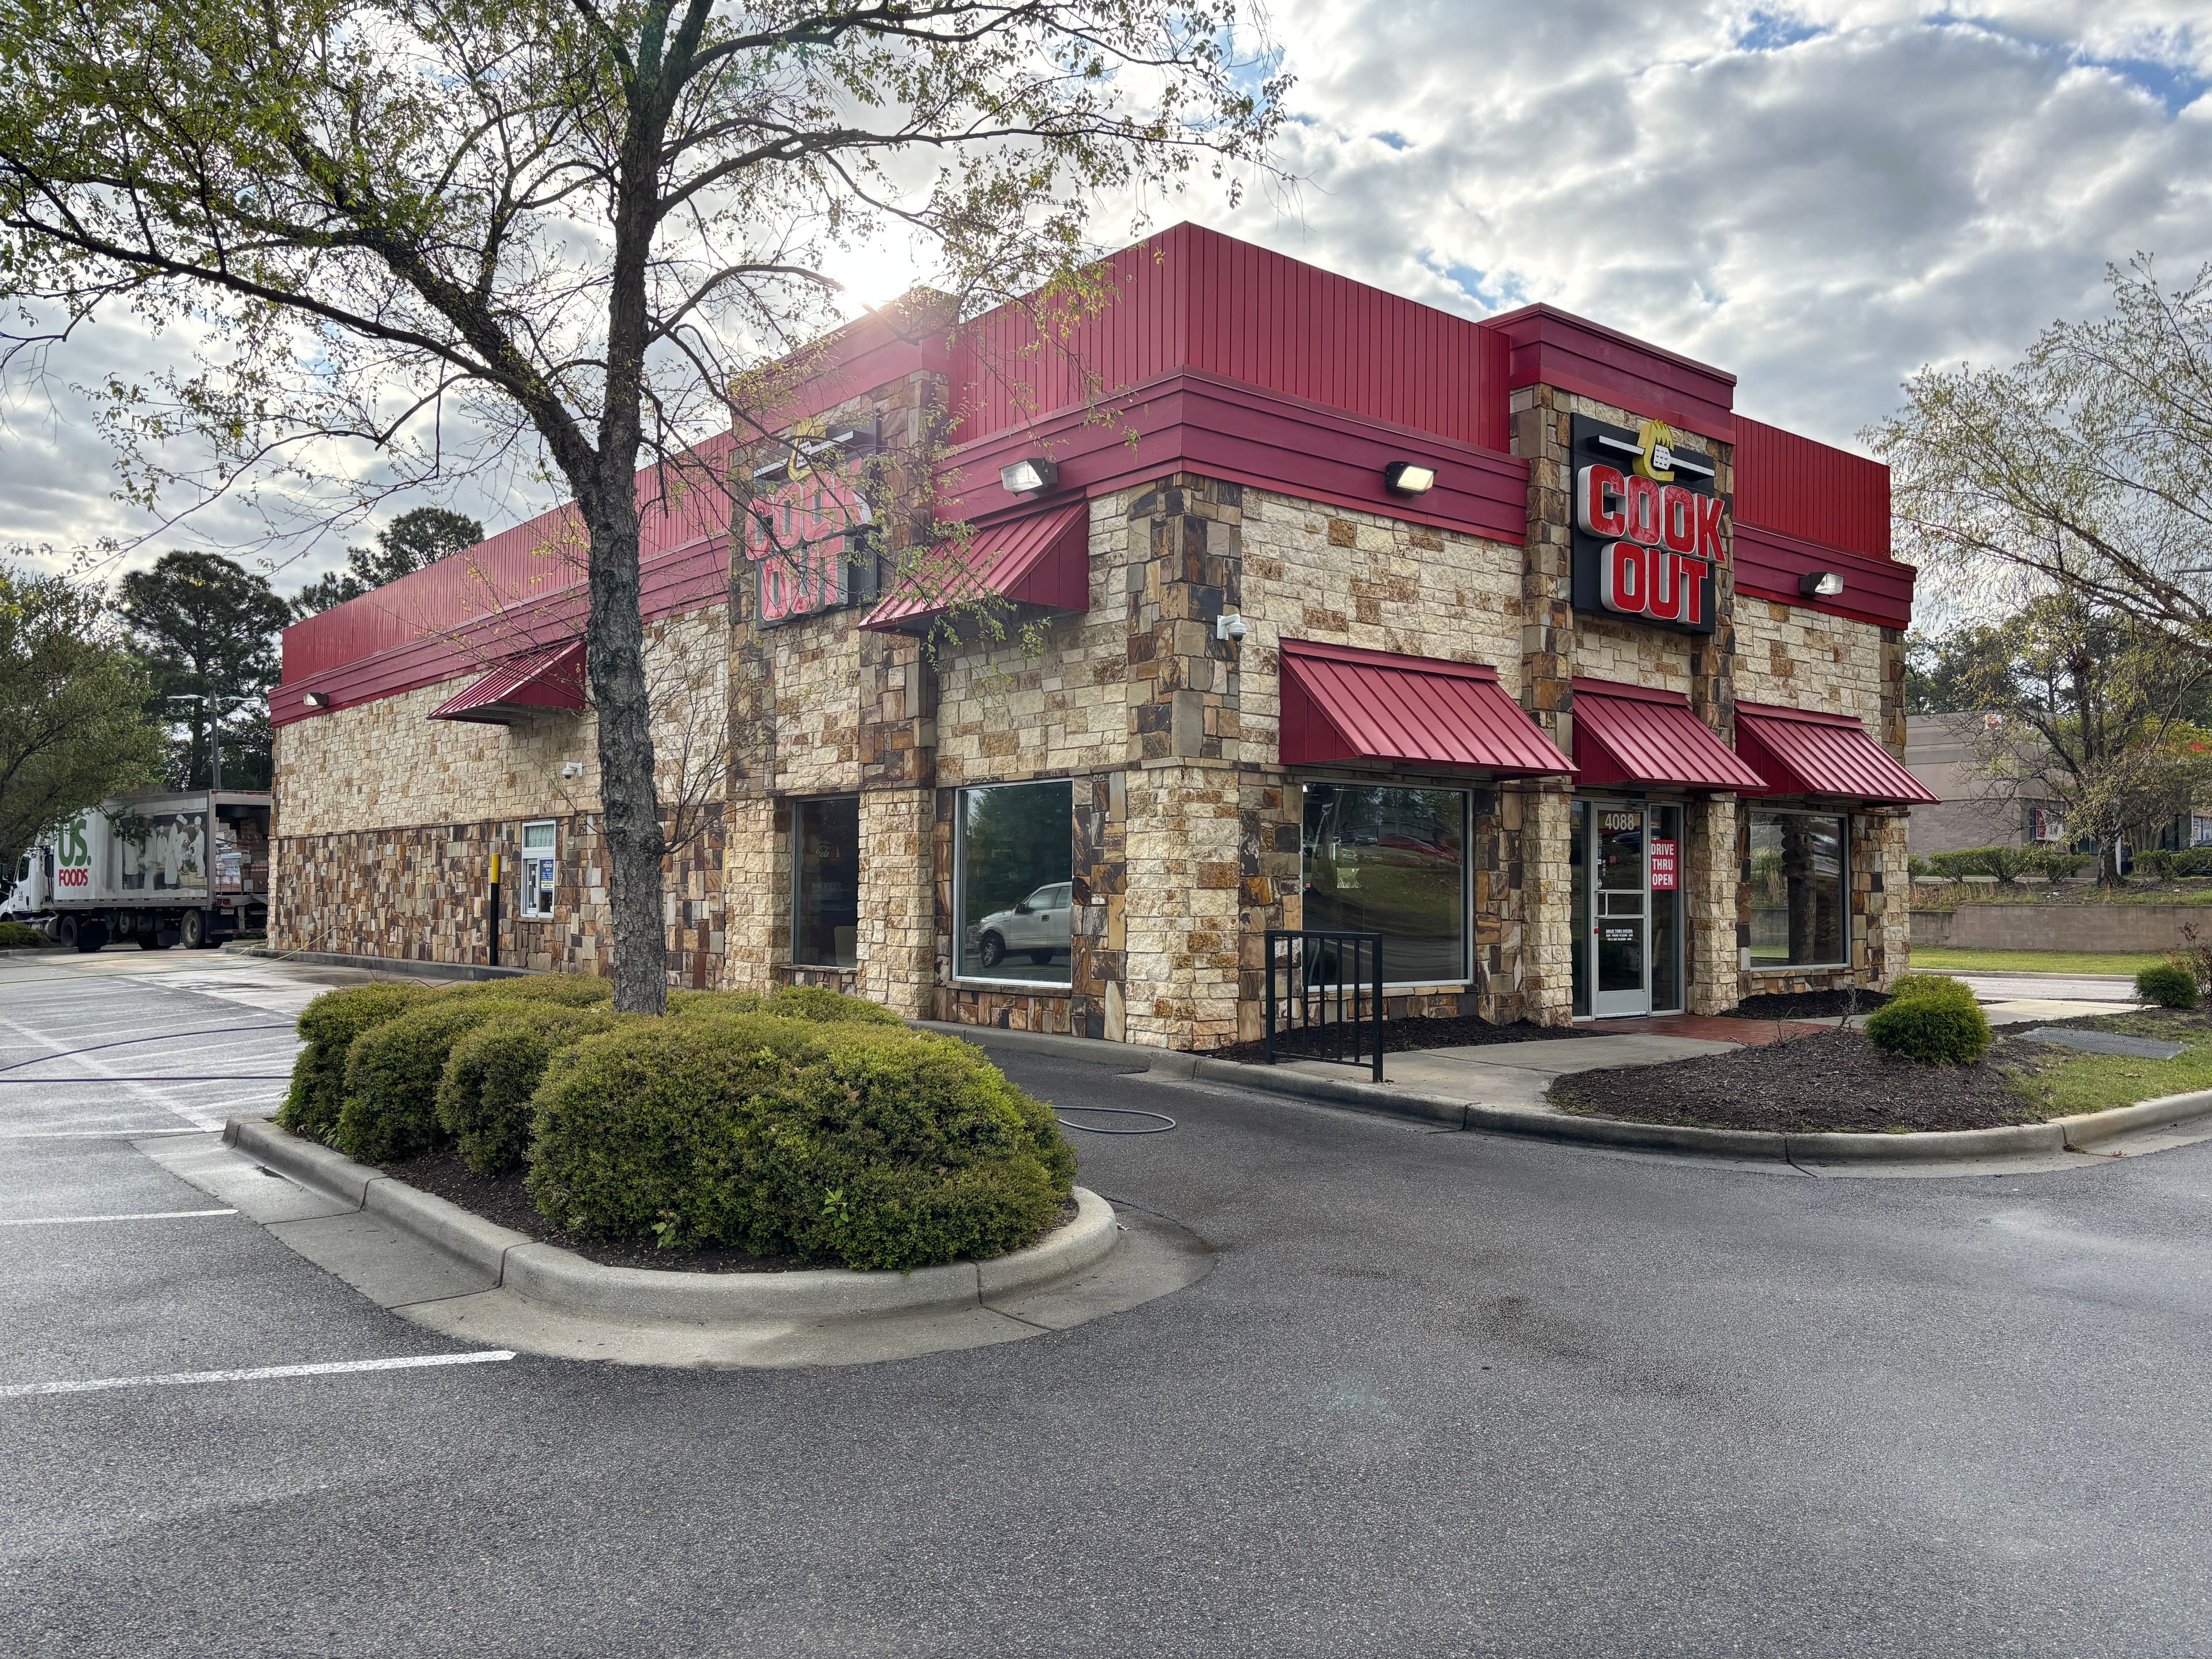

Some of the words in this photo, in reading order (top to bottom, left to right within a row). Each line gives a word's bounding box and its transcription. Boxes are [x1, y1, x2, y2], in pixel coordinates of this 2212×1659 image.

[745, 458, 865, 560] COOK
[1578, 464, 1727, 563] COOK
[762, 535, 844, 622] OUT
[1601, 541, 1708, 624] OUT
[1605, 813, 1635, 831] 4088
[1651, 843, 1674, 855] DRIVE
[1652, 858, 1673, 870] THRU
[59, 868, 88, 887] FOODS
[1652, 873, 1673, 886] OPEN
